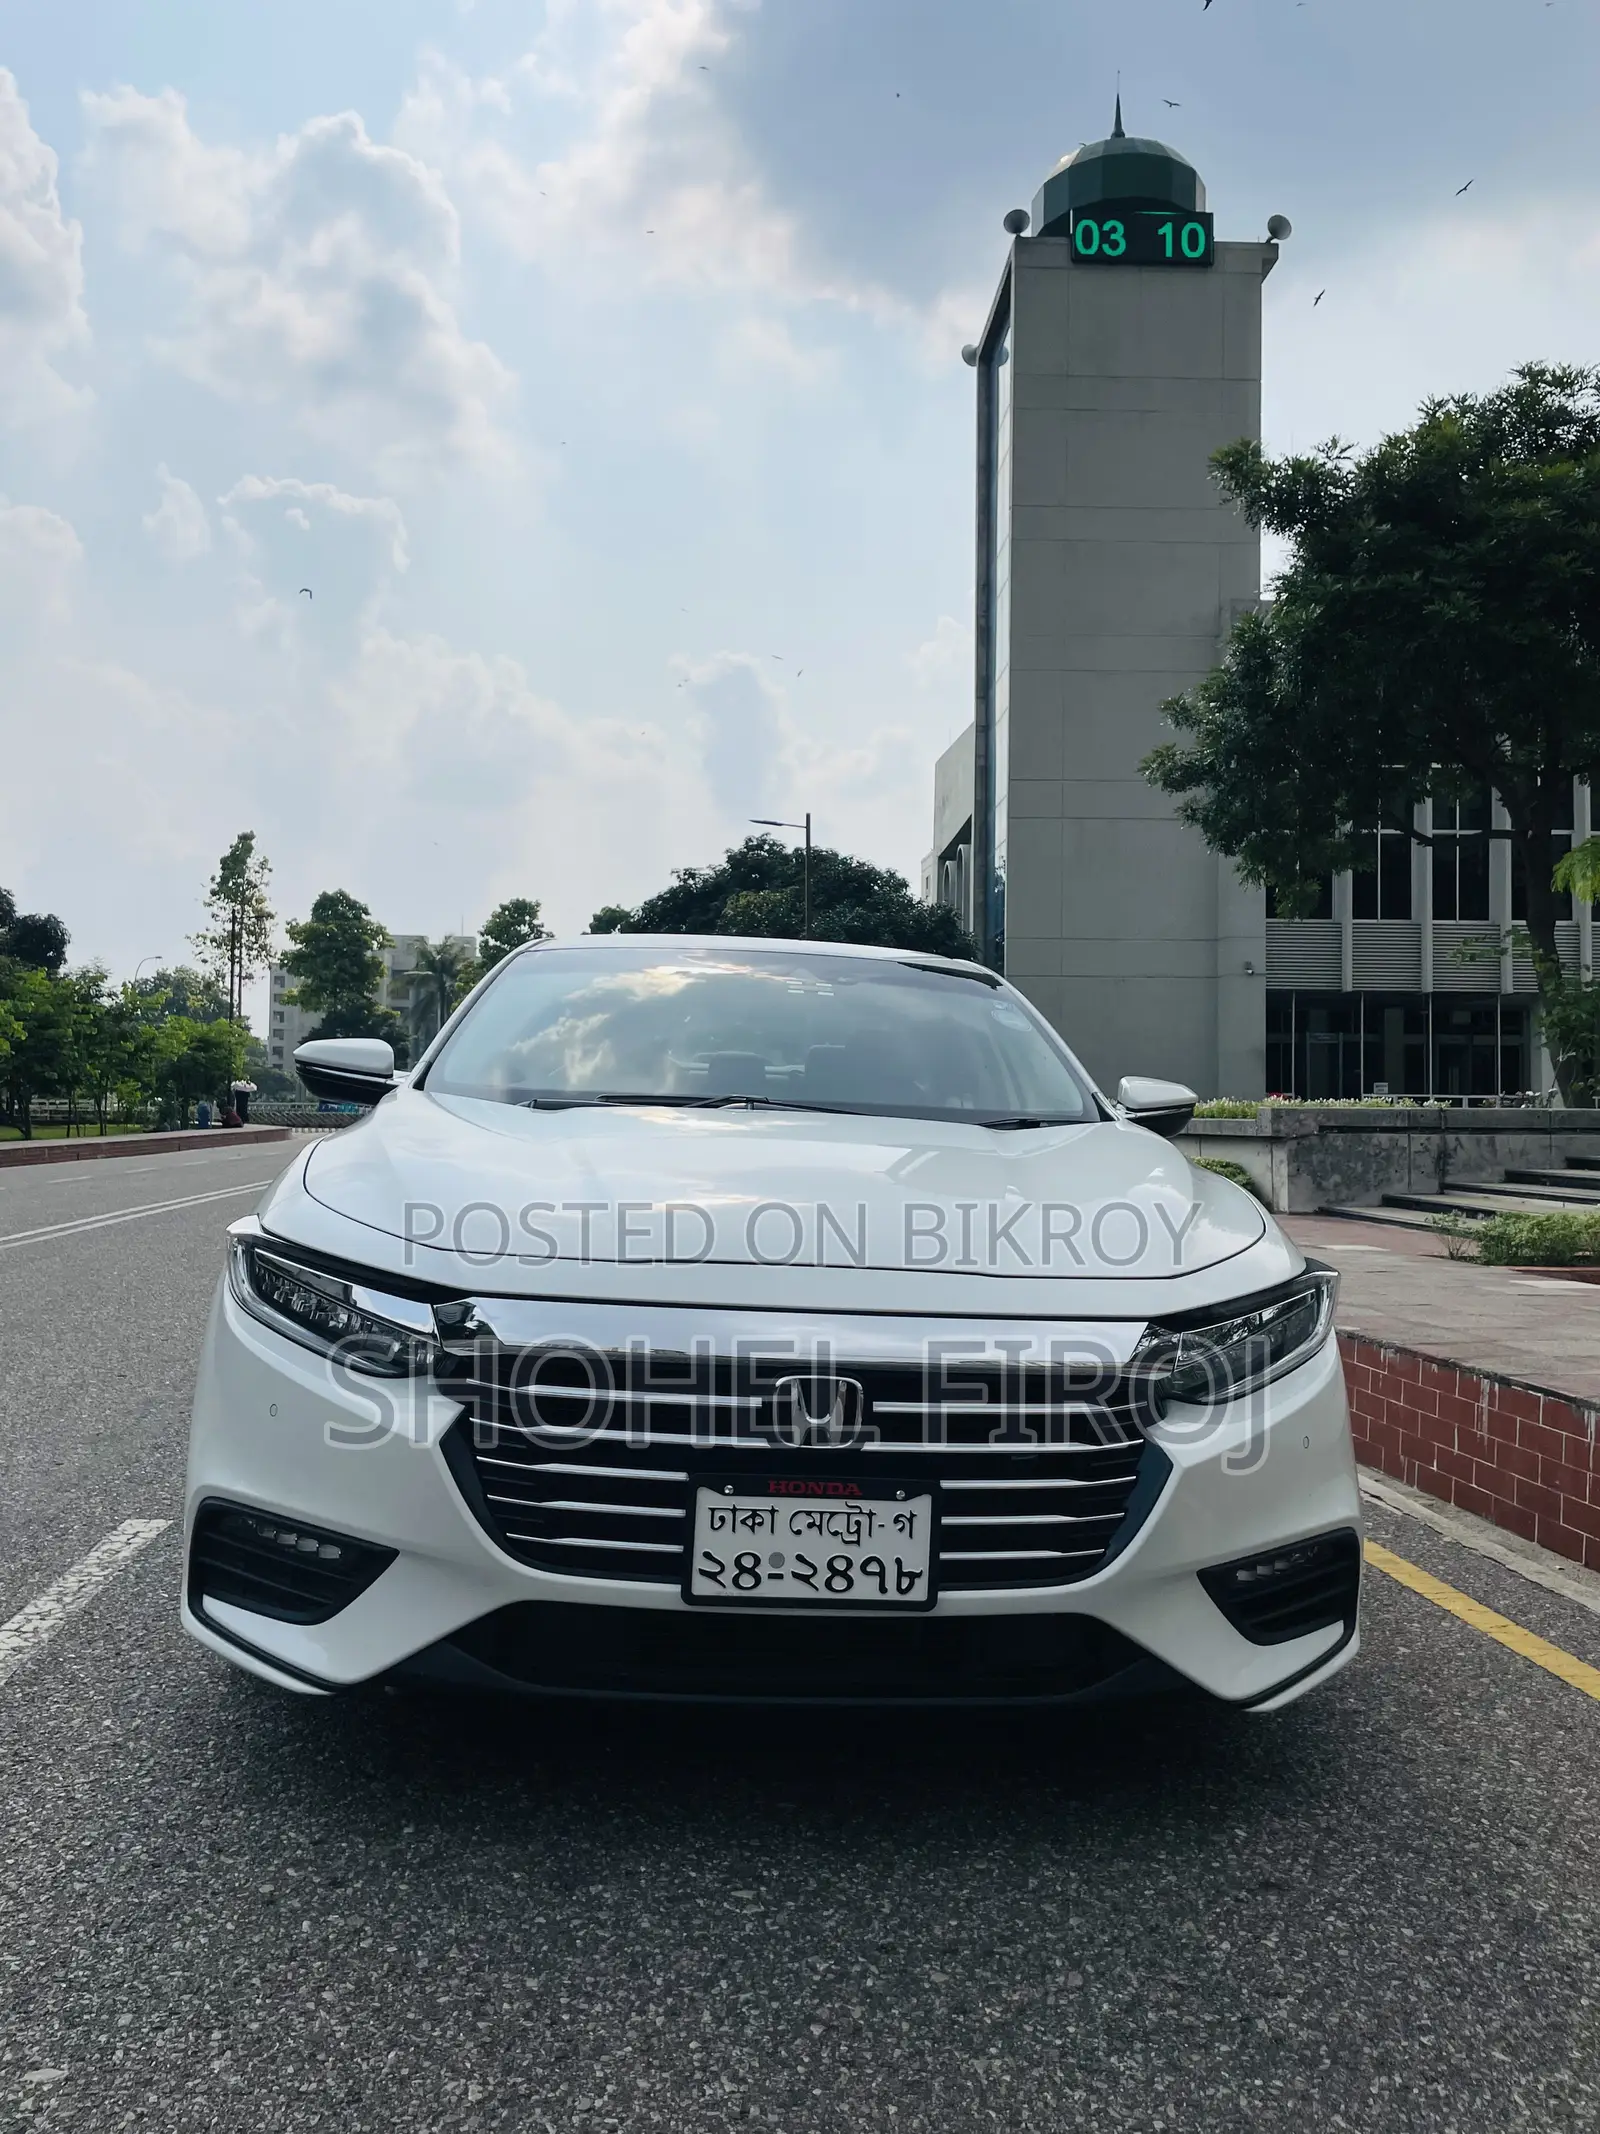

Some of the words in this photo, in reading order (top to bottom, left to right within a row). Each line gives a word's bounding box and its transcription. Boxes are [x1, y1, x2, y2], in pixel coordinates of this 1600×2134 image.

[1075, 219, 1126, 256] 03
[1157, 221, 1206, 258] 10
[768, 1480, 863, 1496] HONDA
[708, 1504, 779, 1535] ঢাকা
[698, 1550, 923, 1595] ২৪-২৪৭৮
